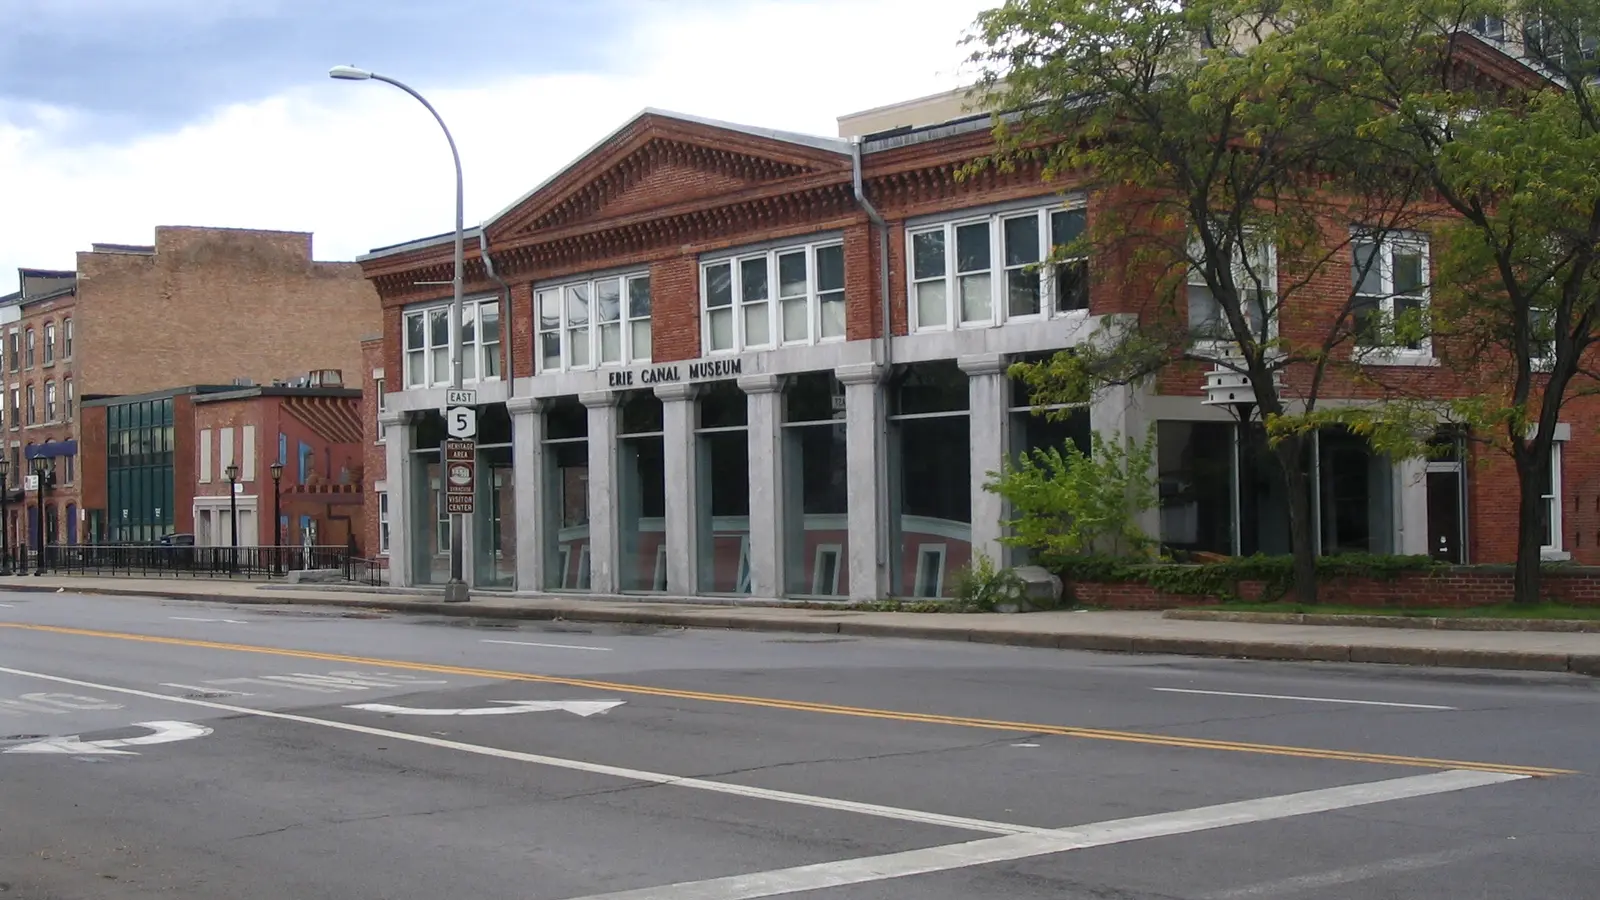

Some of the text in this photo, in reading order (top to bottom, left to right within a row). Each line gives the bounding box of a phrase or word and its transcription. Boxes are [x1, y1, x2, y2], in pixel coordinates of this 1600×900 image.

[609, 358, 742, 387] ERIE CANAL MUSEUM
[450, 392, 472, 402] EAST
[457, 414, 467, 431] 5
[448, 495, 472, 503] VISITOR
[448, 503, 472, 512] CENTER
